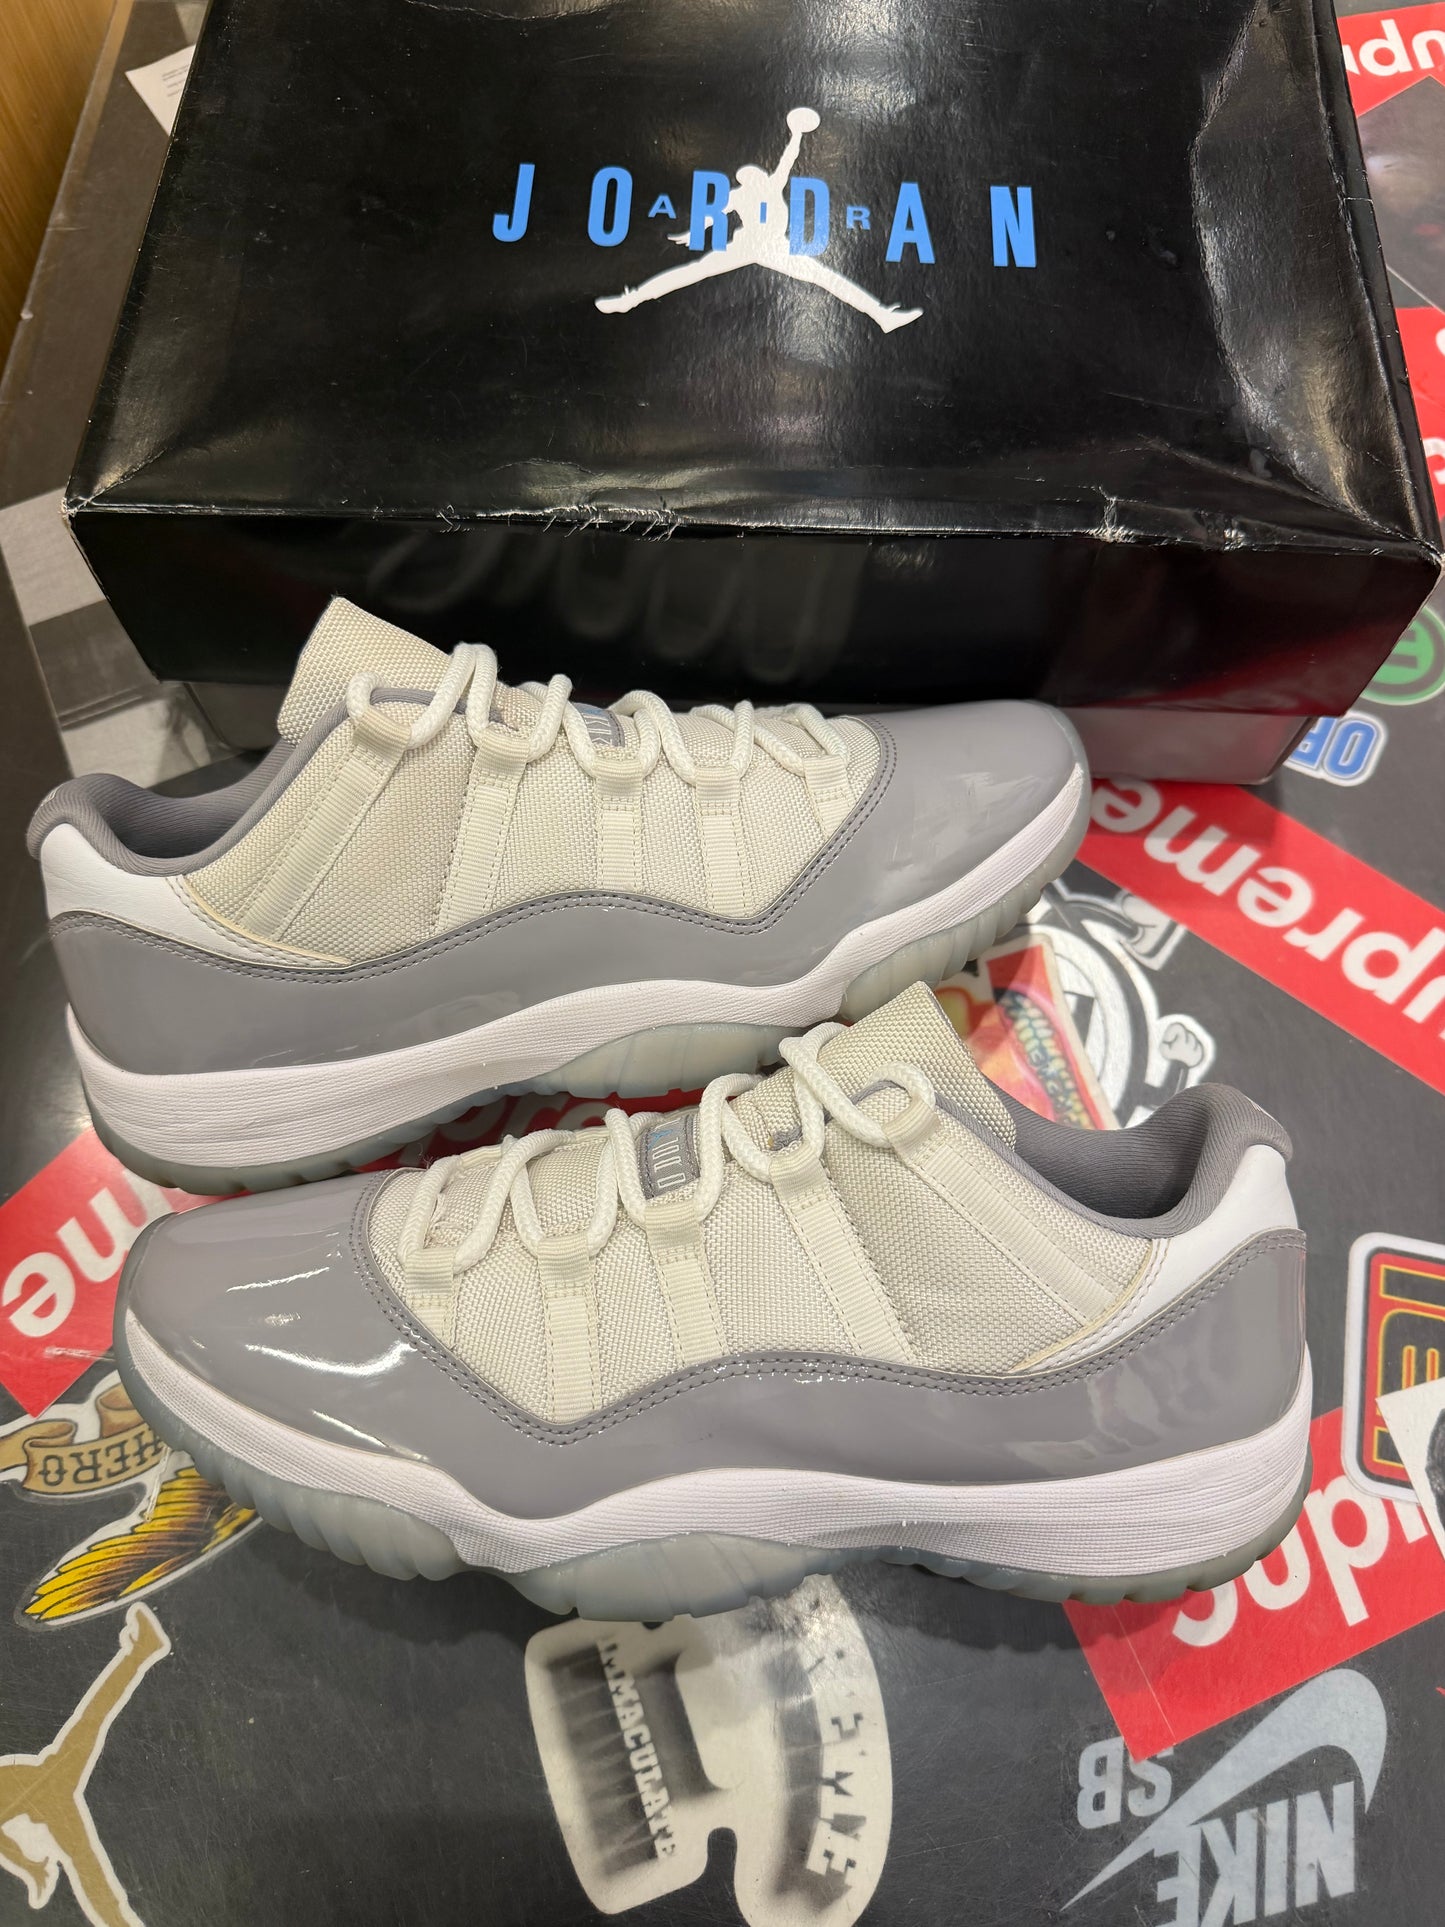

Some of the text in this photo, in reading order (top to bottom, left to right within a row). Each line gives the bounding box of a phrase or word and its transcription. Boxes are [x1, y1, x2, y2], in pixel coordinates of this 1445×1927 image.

[492, 161, 1037, 269] JORDAN
[40, 1431, 162, 1488] HERO
[596, 1636, 679, 1860] IMMACULATE
[1076, 1737, 1173, 1830] SB
[1153, 1781, 1356, 1927] NIKE
